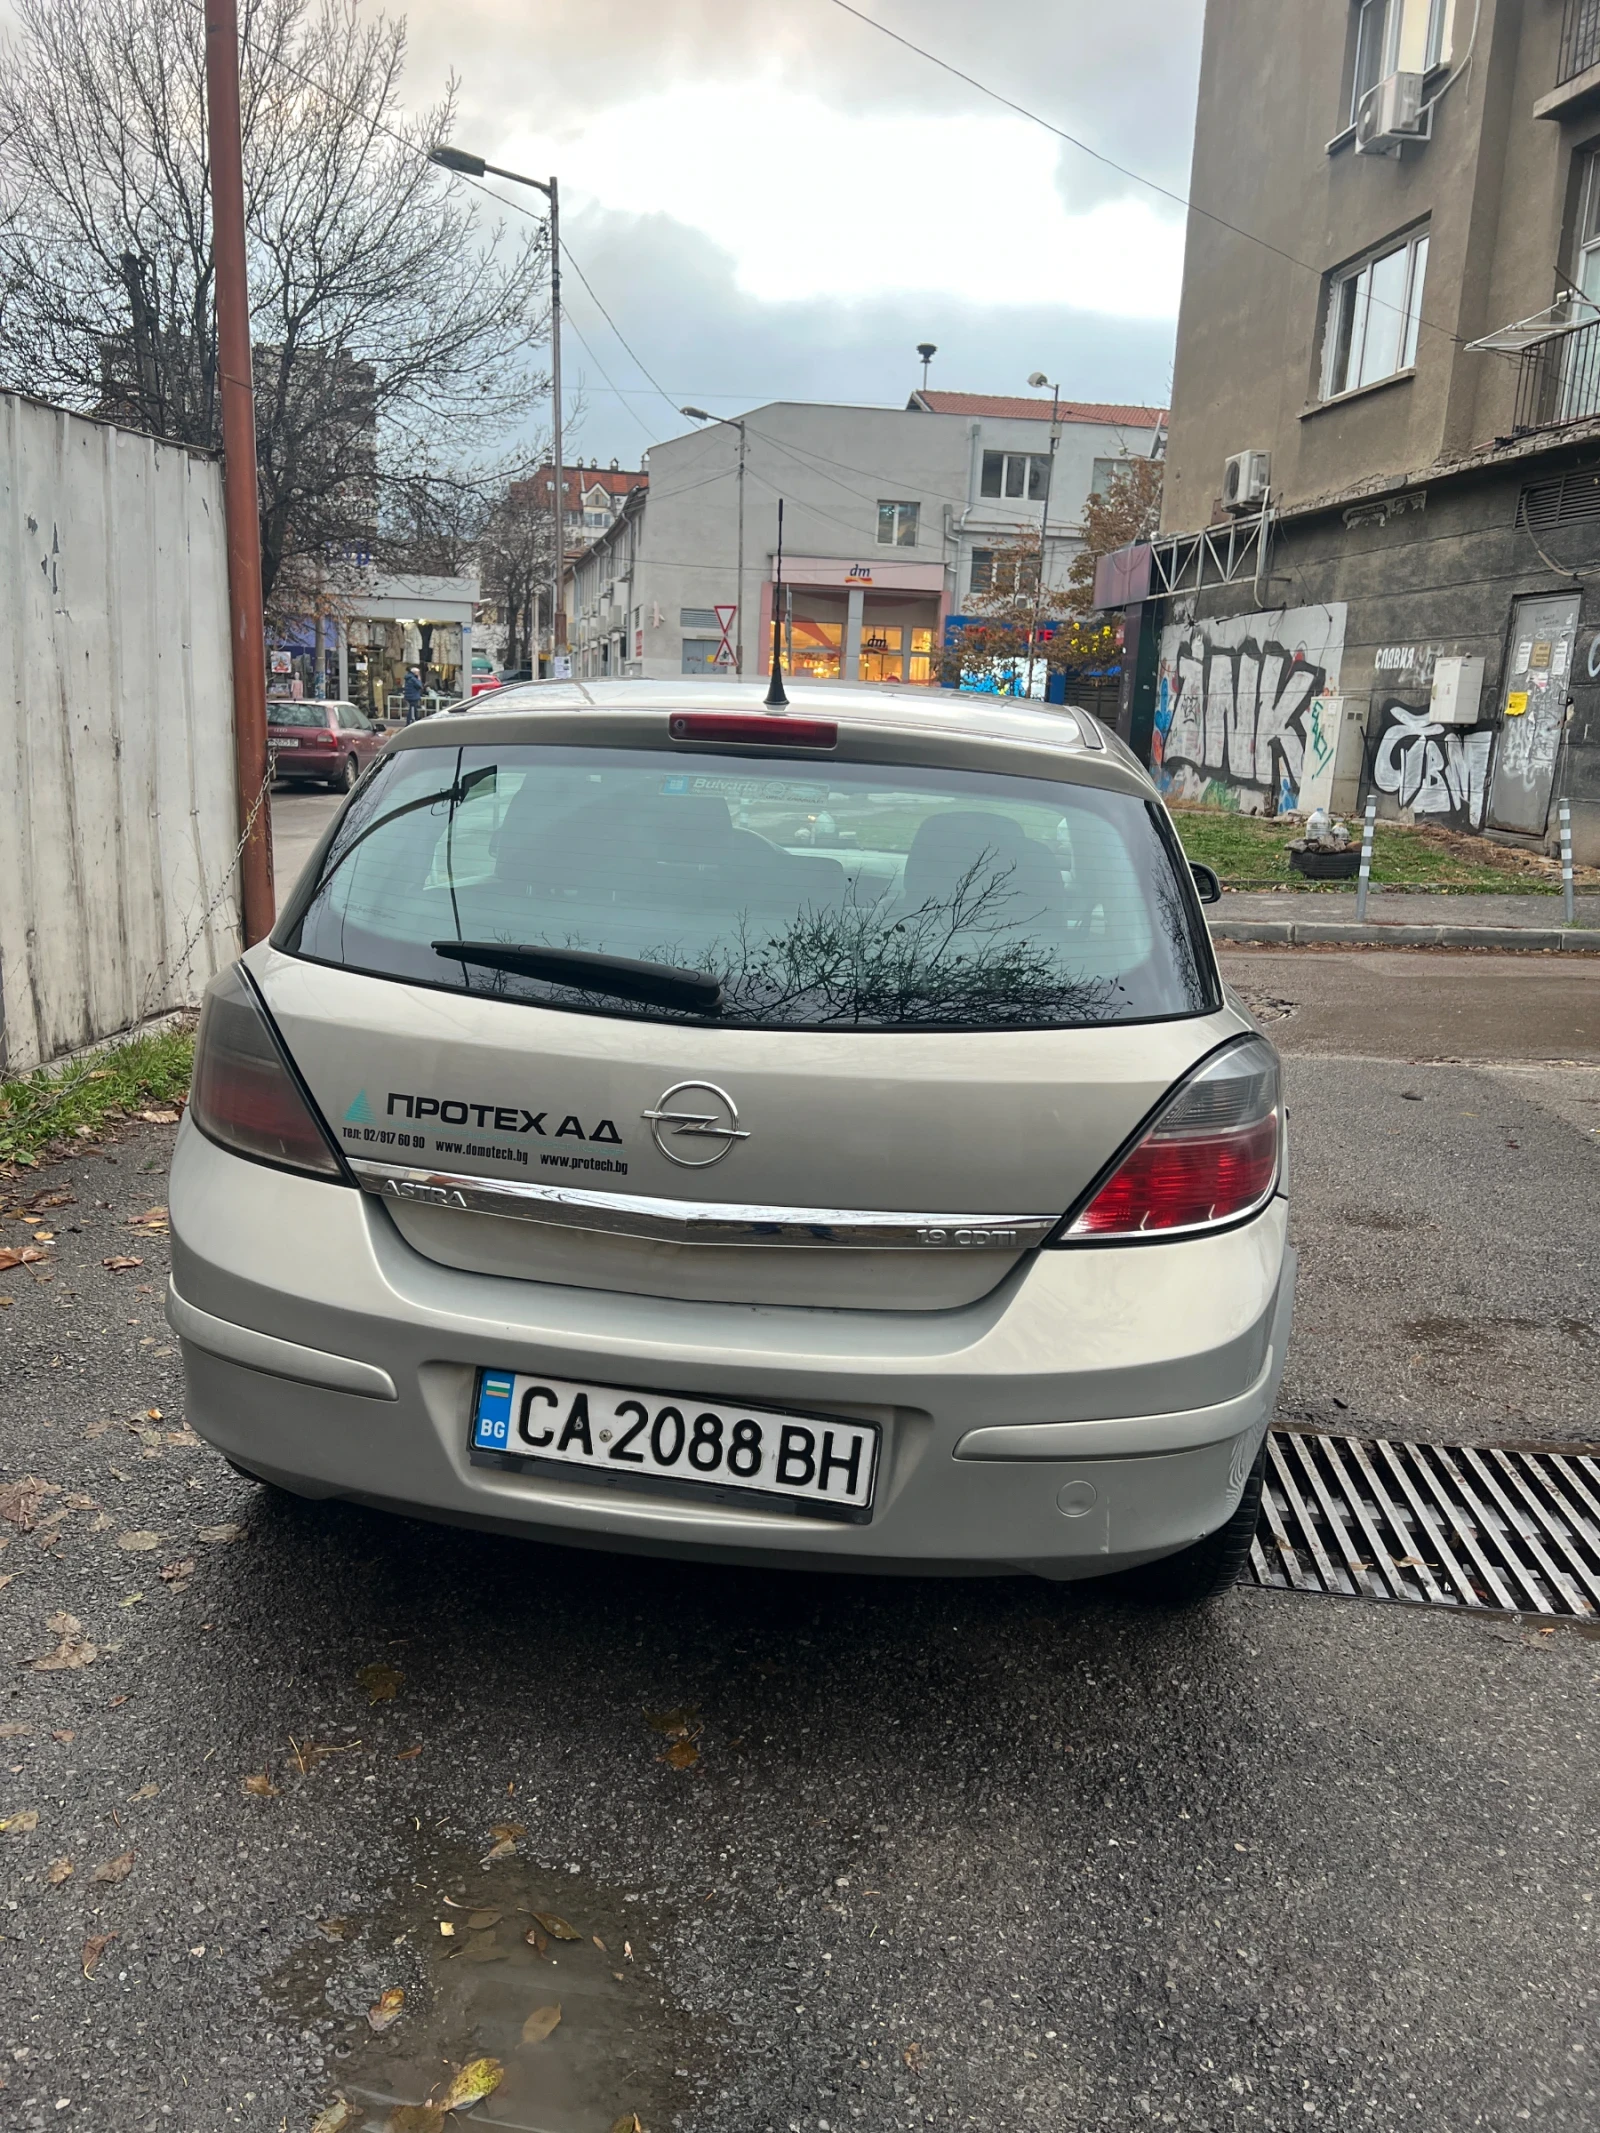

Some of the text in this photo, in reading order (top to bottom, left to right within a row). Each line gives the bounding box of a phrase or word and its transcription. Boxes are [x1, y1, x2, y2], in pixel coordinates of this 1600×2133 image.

[849, 563, 871, 577] dm
[867, 634, 887, 648] dm
[387, 1092, 548, 1136] ПРОТЕХ
[554, 1115, 623, 1145] АД
[342, 1126, 362, 1140] тел:
[364, 1128, 396, 1145] 02/917
[398, 1133, 411, 1147] 60
[412, 1135, 426, 1149] 90
[436, 1140, 529, 1166] www.domotech.bg
[540, 1153, 628, 1176] www.protech.bg
[381, 1179, 467, 1208] ASTRA
[480, 1418, 506, 1438] BG
[517, 1386, 862, 1495] CA 2088 BH
